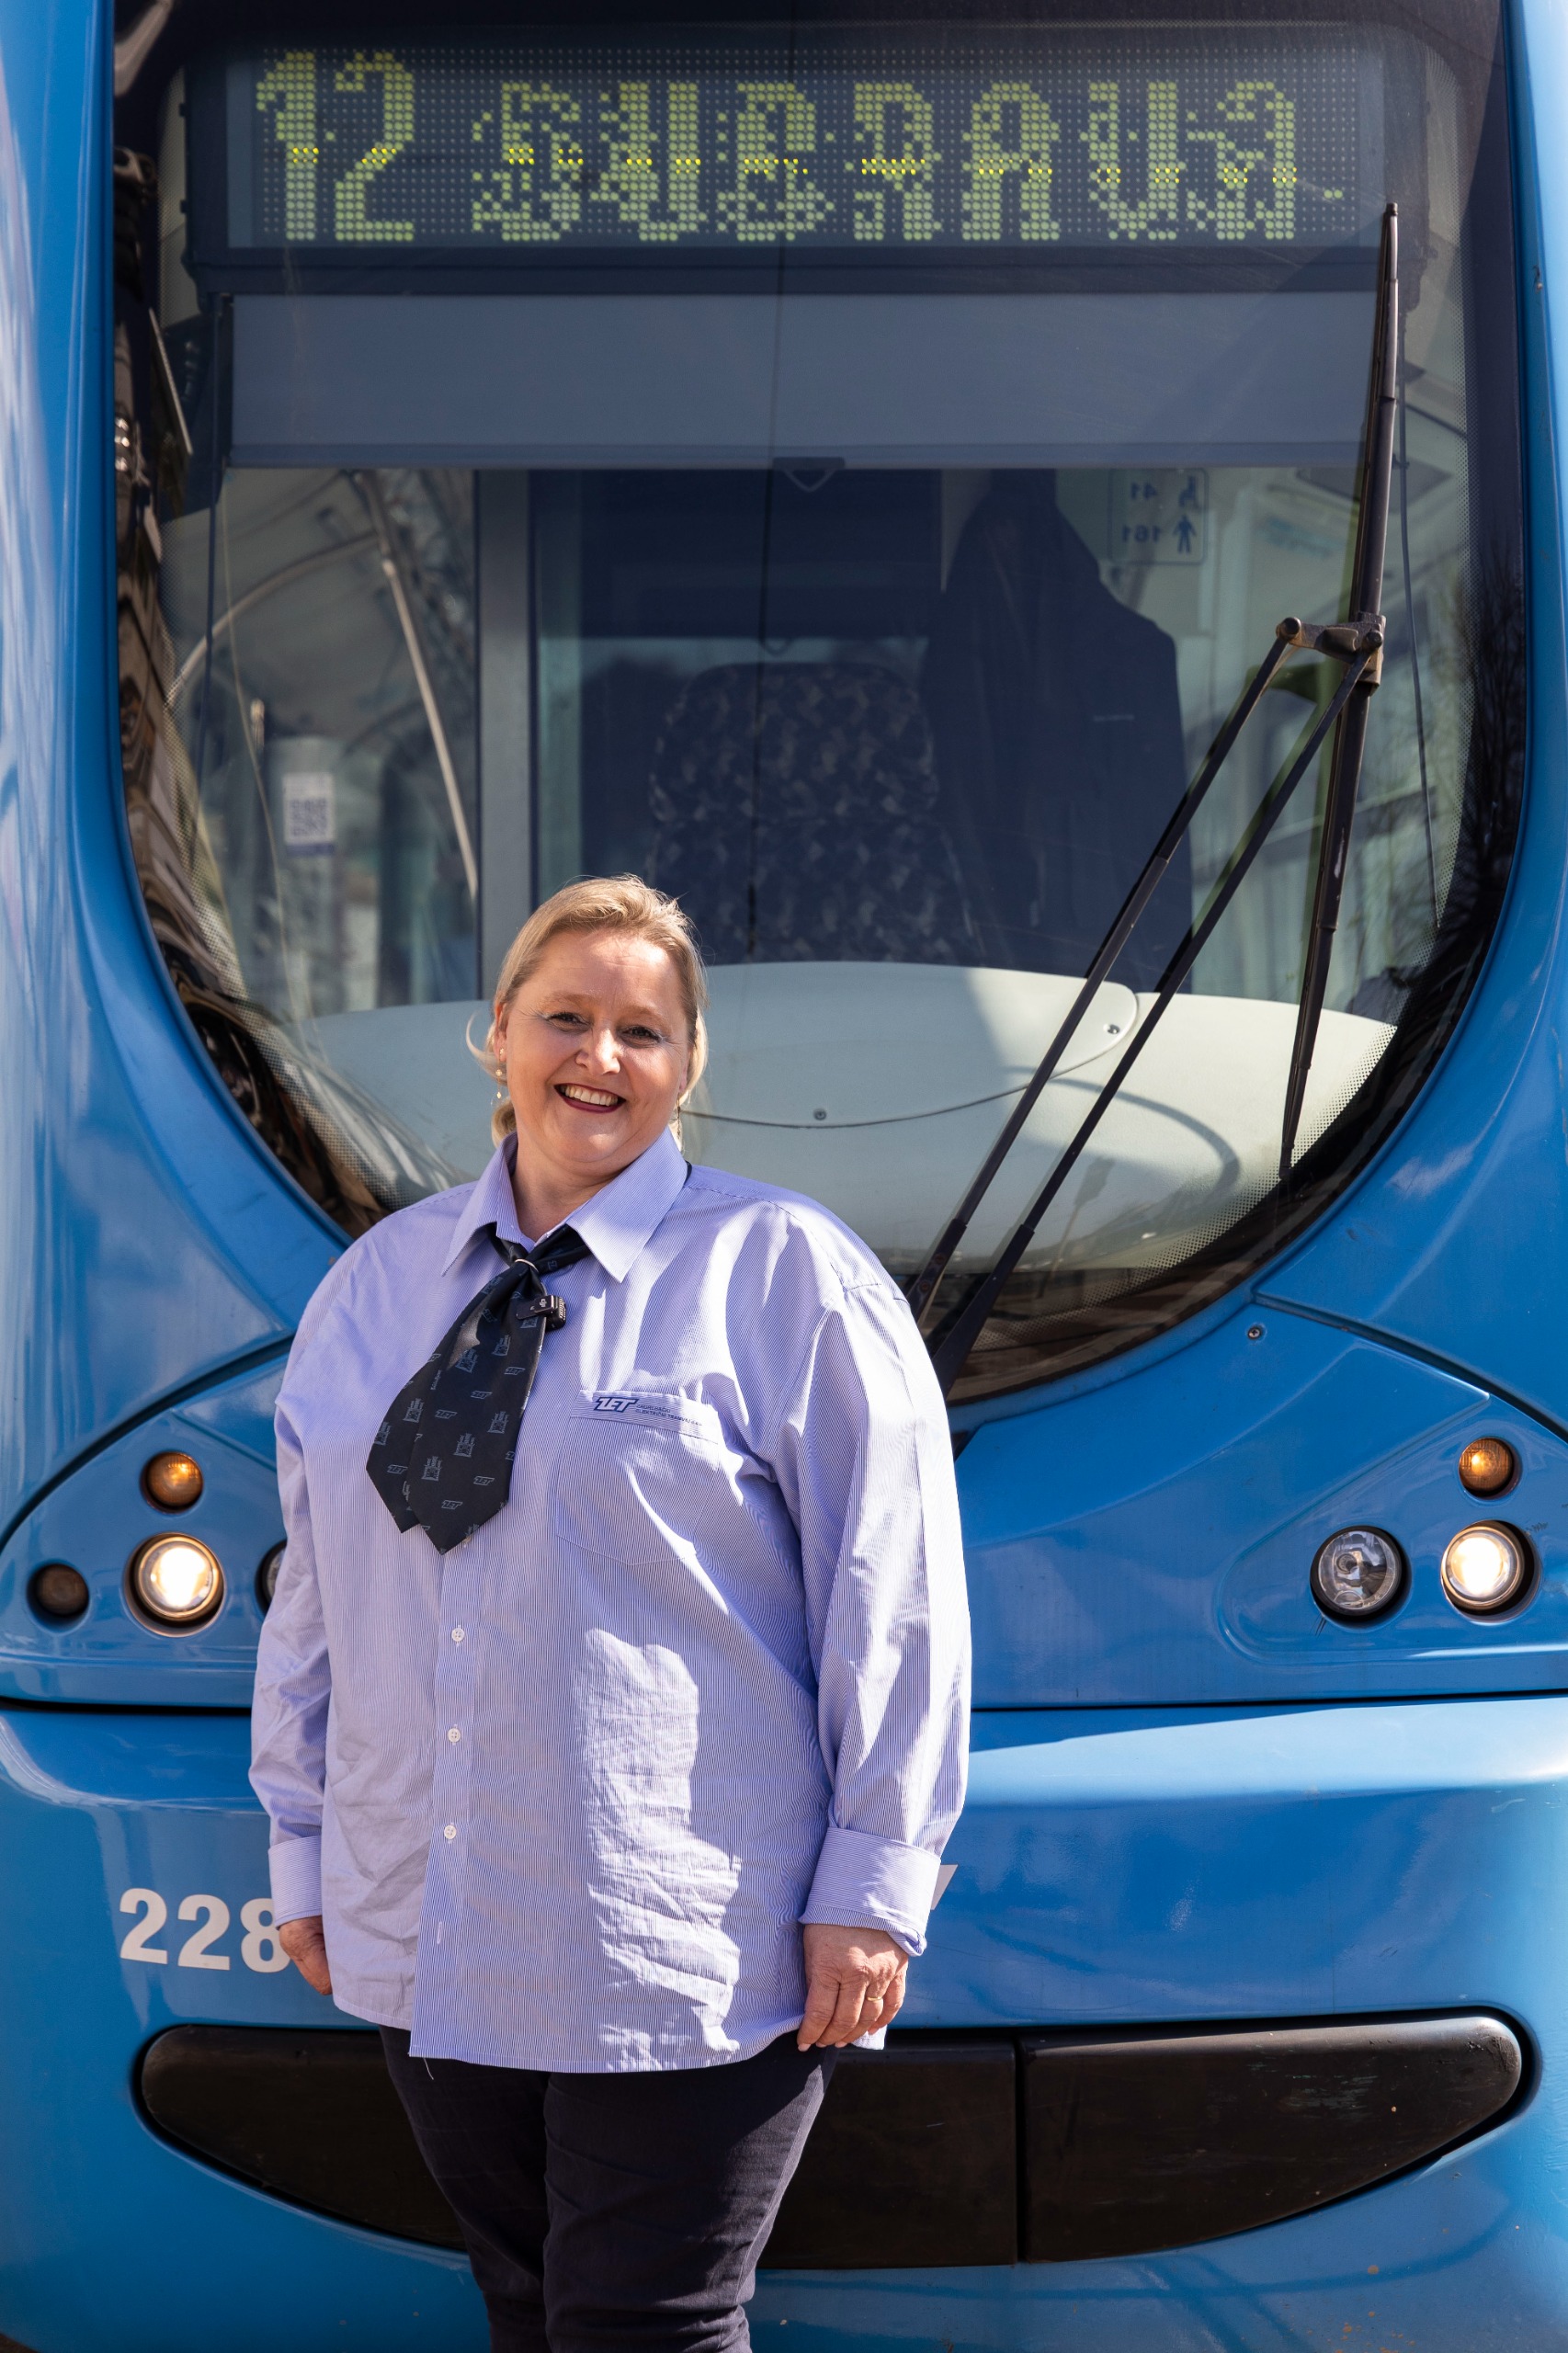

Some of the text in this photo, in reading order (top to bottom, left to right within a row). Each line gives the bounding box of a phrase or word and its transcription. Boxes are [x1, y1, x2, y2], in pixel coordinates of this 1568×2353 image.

[256, 51, 415, 241] 12
[594, 1397, 639, 1413] ZET
[435, 1409, 458, 1419] ZET
[387, 1464, 408, 1474] ZET
[473, 1476, 495, 1485] ZET
[441, 1499, 463, 1509] ZET
